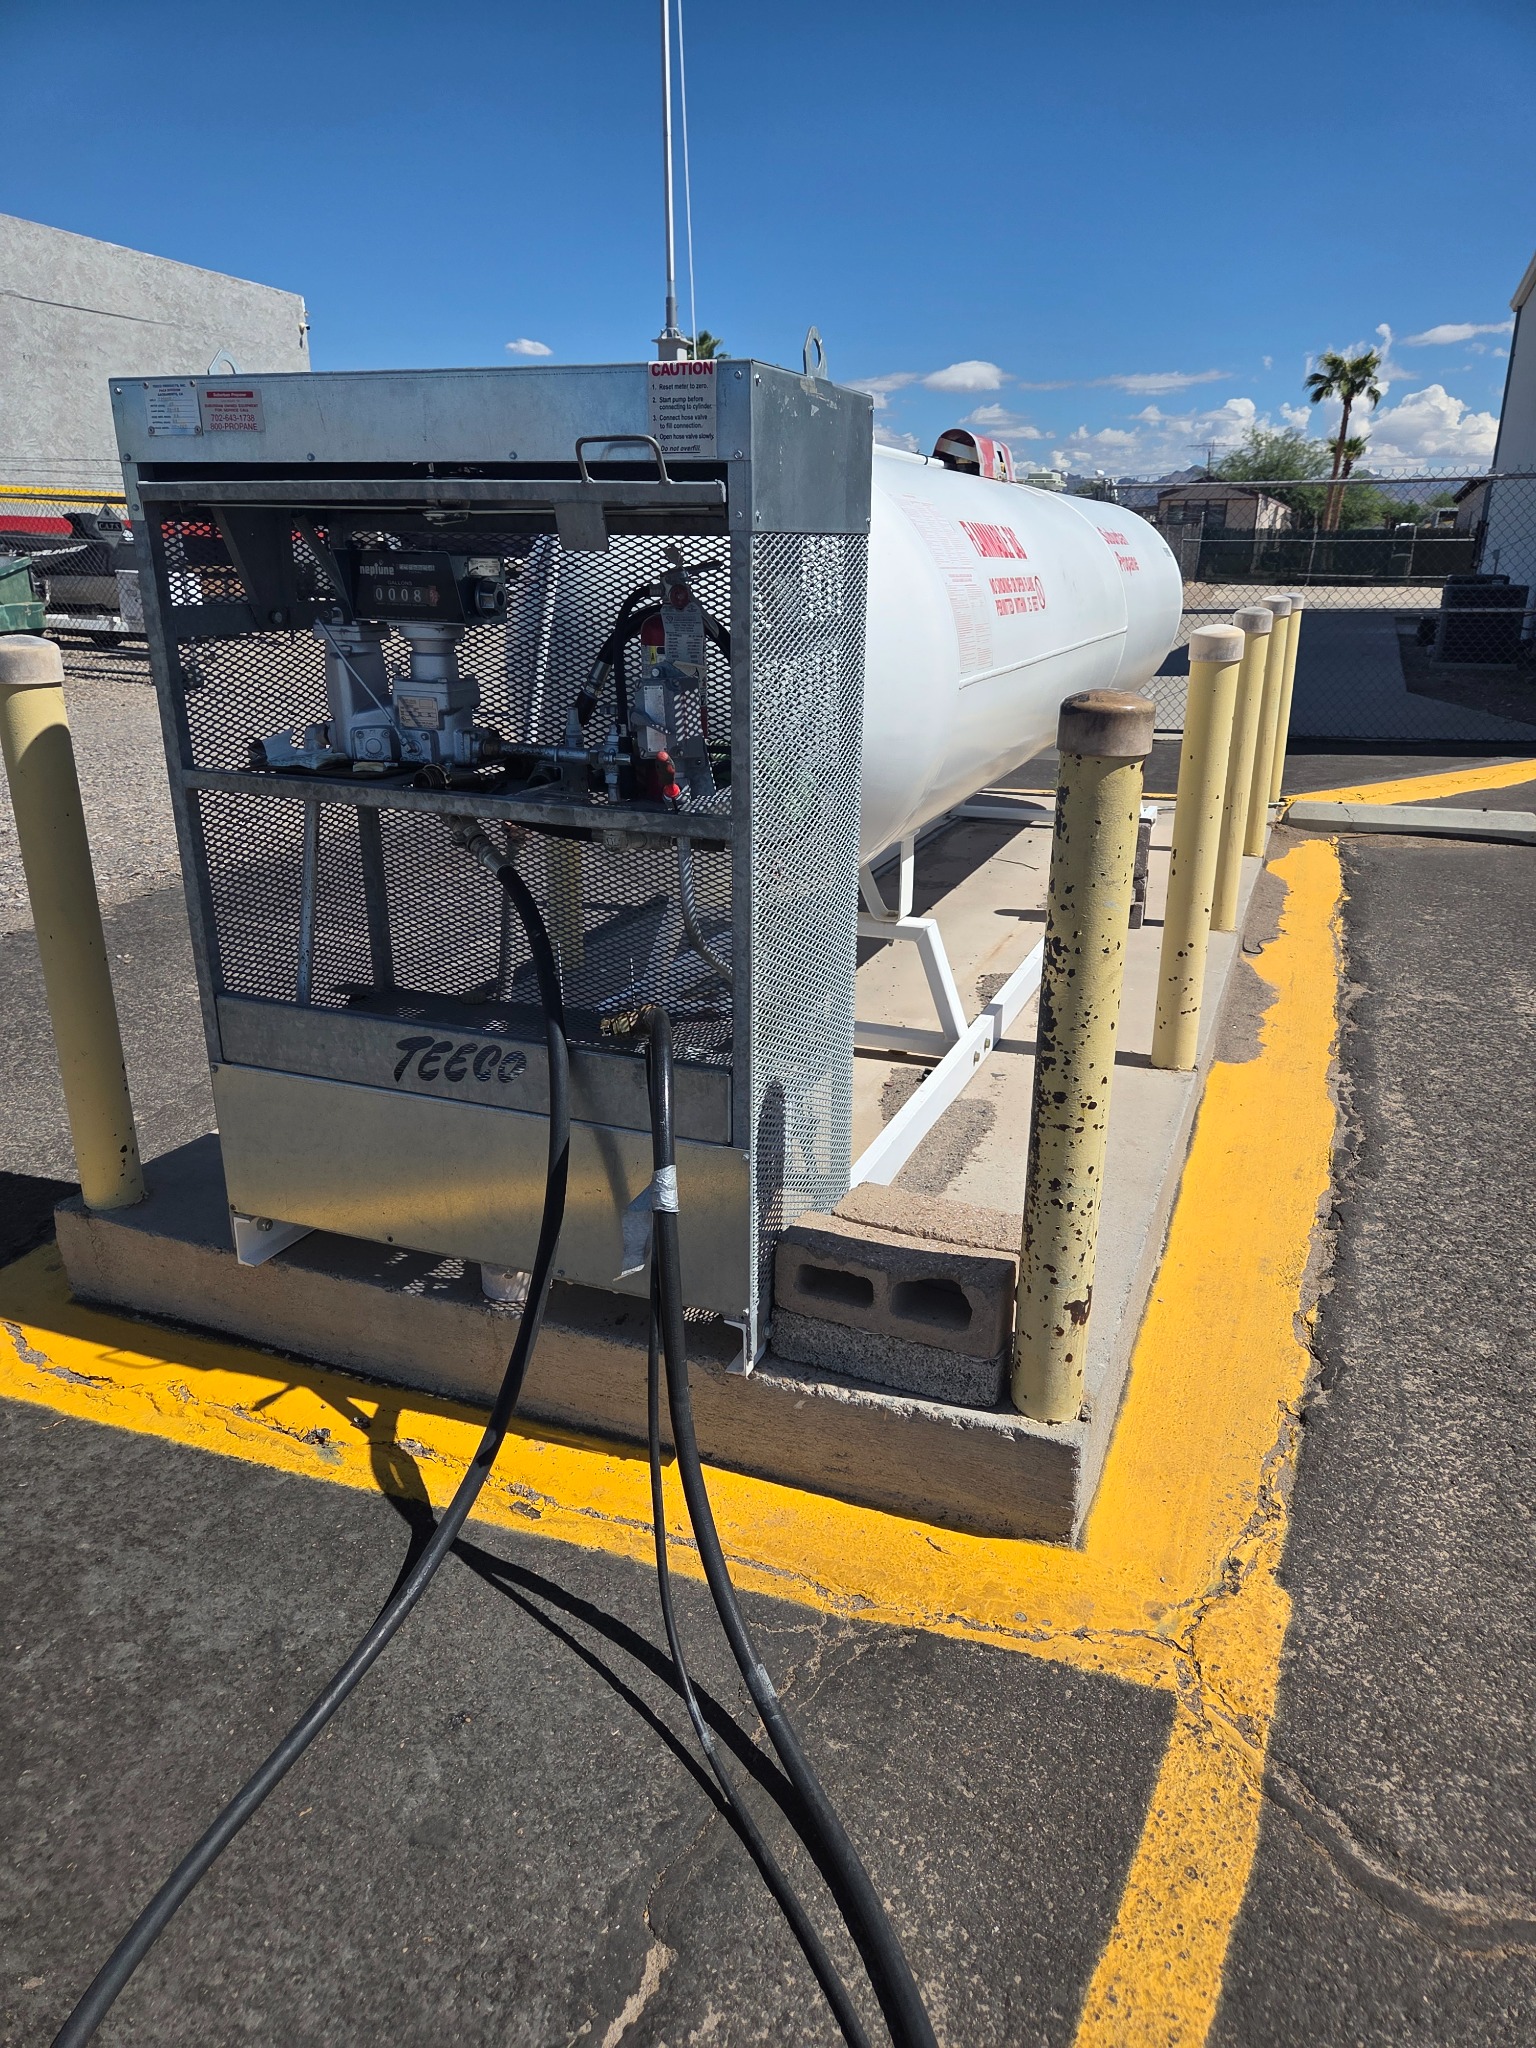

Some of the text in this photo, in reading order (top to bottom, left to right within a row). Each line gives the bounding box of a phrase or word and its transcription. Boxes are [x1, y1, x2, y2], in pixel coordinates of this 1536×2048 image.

[652, 362, 713, 376] CAUTION
[210, 414, 255, 422] 702-643-1738
[360, 562, 394, 577] neptune
[394, 1036, 527, 1084] TEECO
